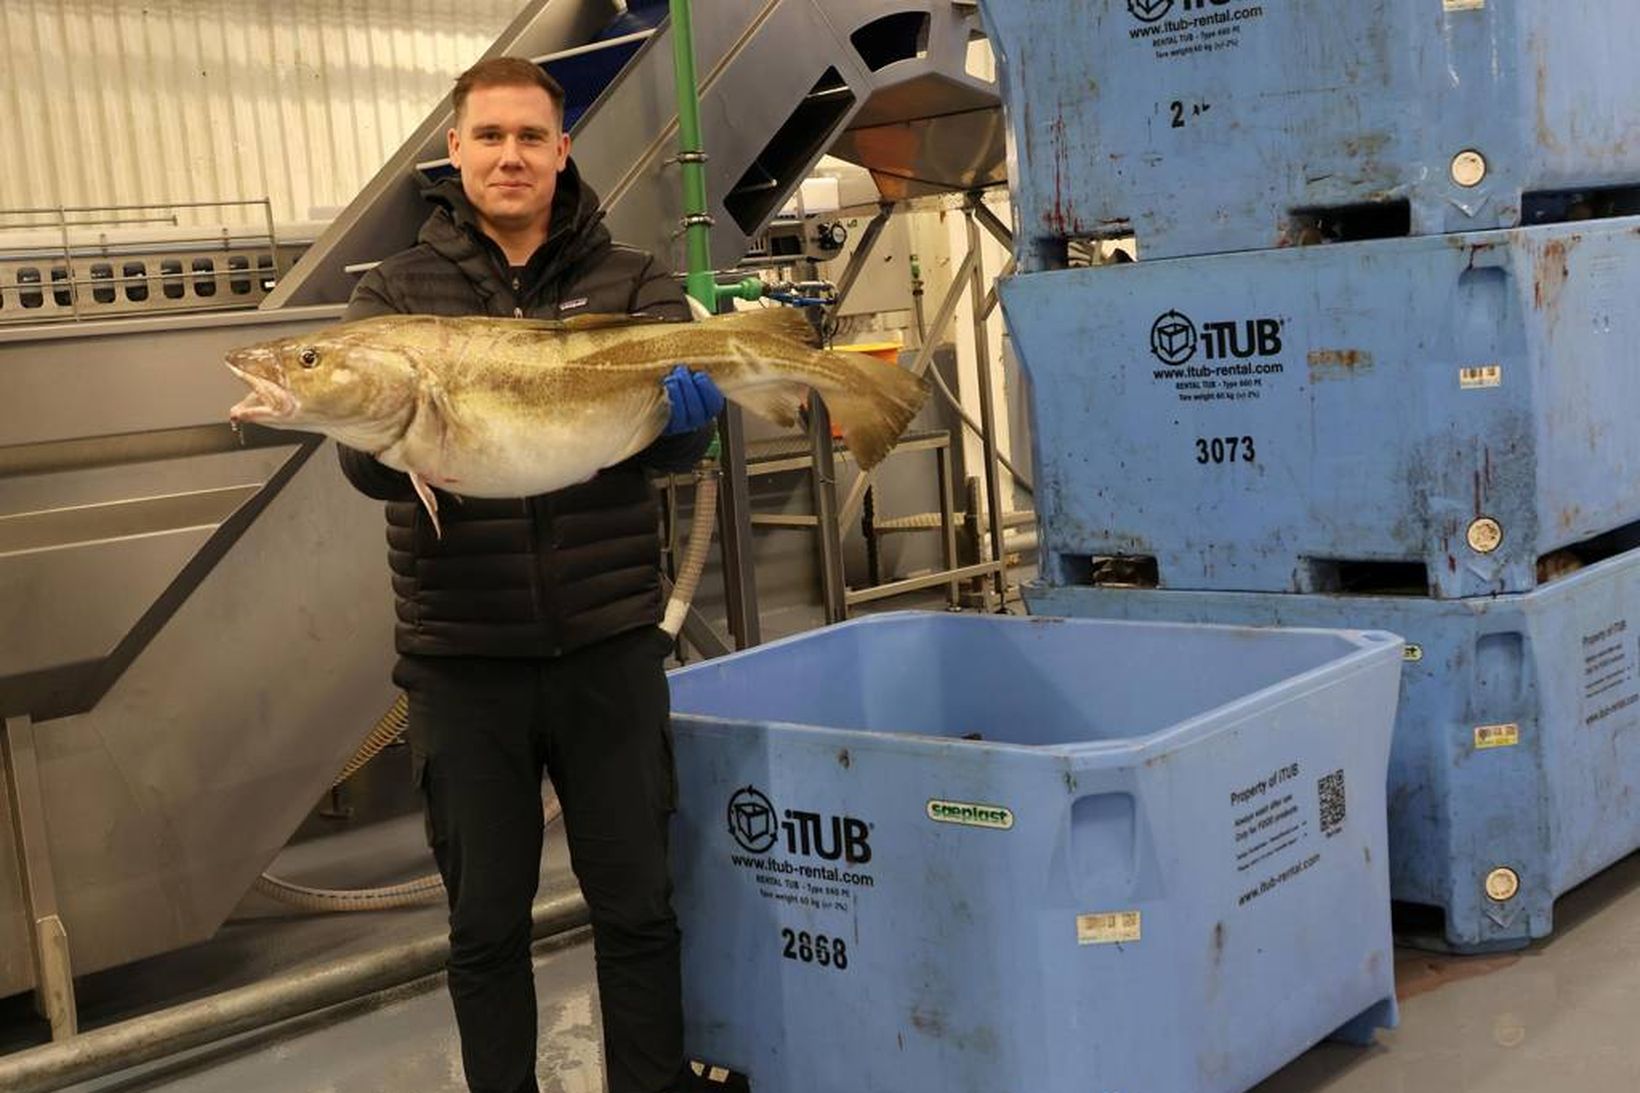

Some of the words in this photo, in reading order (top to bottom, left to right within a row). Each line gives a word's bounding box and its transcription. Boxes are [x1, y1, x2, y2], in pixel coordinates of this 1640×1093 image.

[1129, 6, 1263, 39] www.itub-rental.com
[1200, 318, 1282, 359] iTUB
[1153, 362, 1283, 379] www.itub-rental.com
[1196, 435, 1256, 464] 3073
[1230, 781, 1267, 806] Property
[1268, 771, 1278, 788] of
[781, 809, 872, 864] iTUB
[731, 854, 874, 887] www.itub-rental.com
[782, 927, 848, 971] 2868
